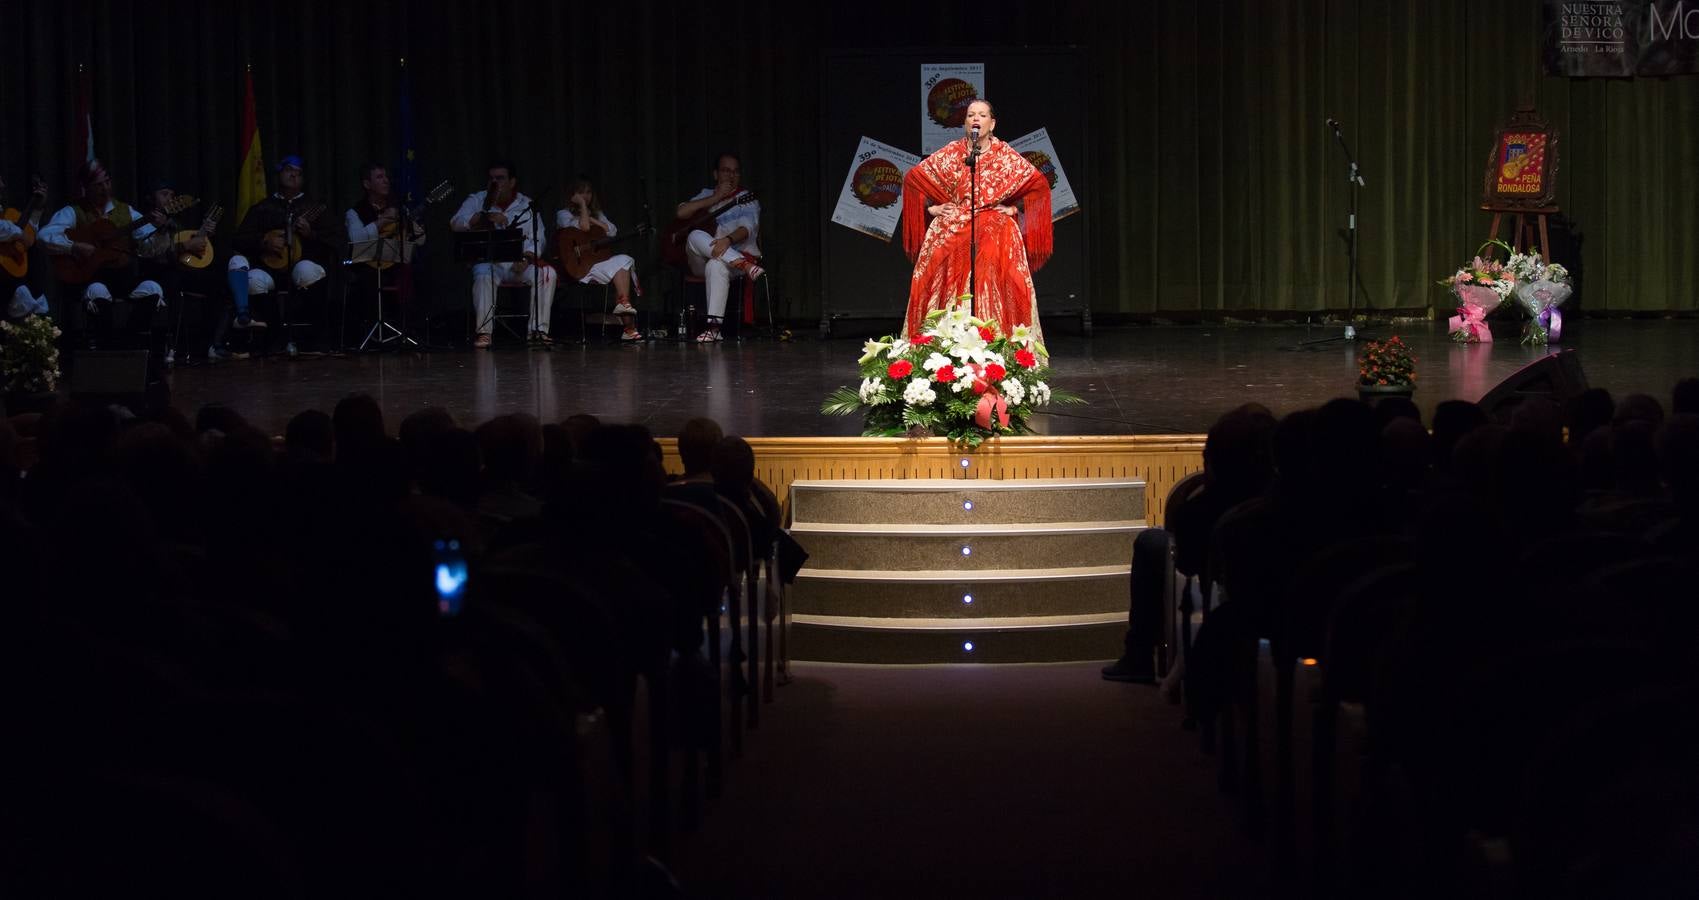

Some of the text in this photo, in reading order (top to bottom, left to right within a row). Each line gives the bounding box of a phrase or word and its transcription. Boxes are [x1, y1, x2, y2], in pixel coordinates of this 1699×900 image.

[1561, 3, 1623, 15] NUESTRA
[1560, 45, 1588, 53] Arnedo
[1595, 45, 1604, 53] La
[1522, 172, 1541, 183] PEÑA
[1497, 183, 1541, 193] RONDALOSA
